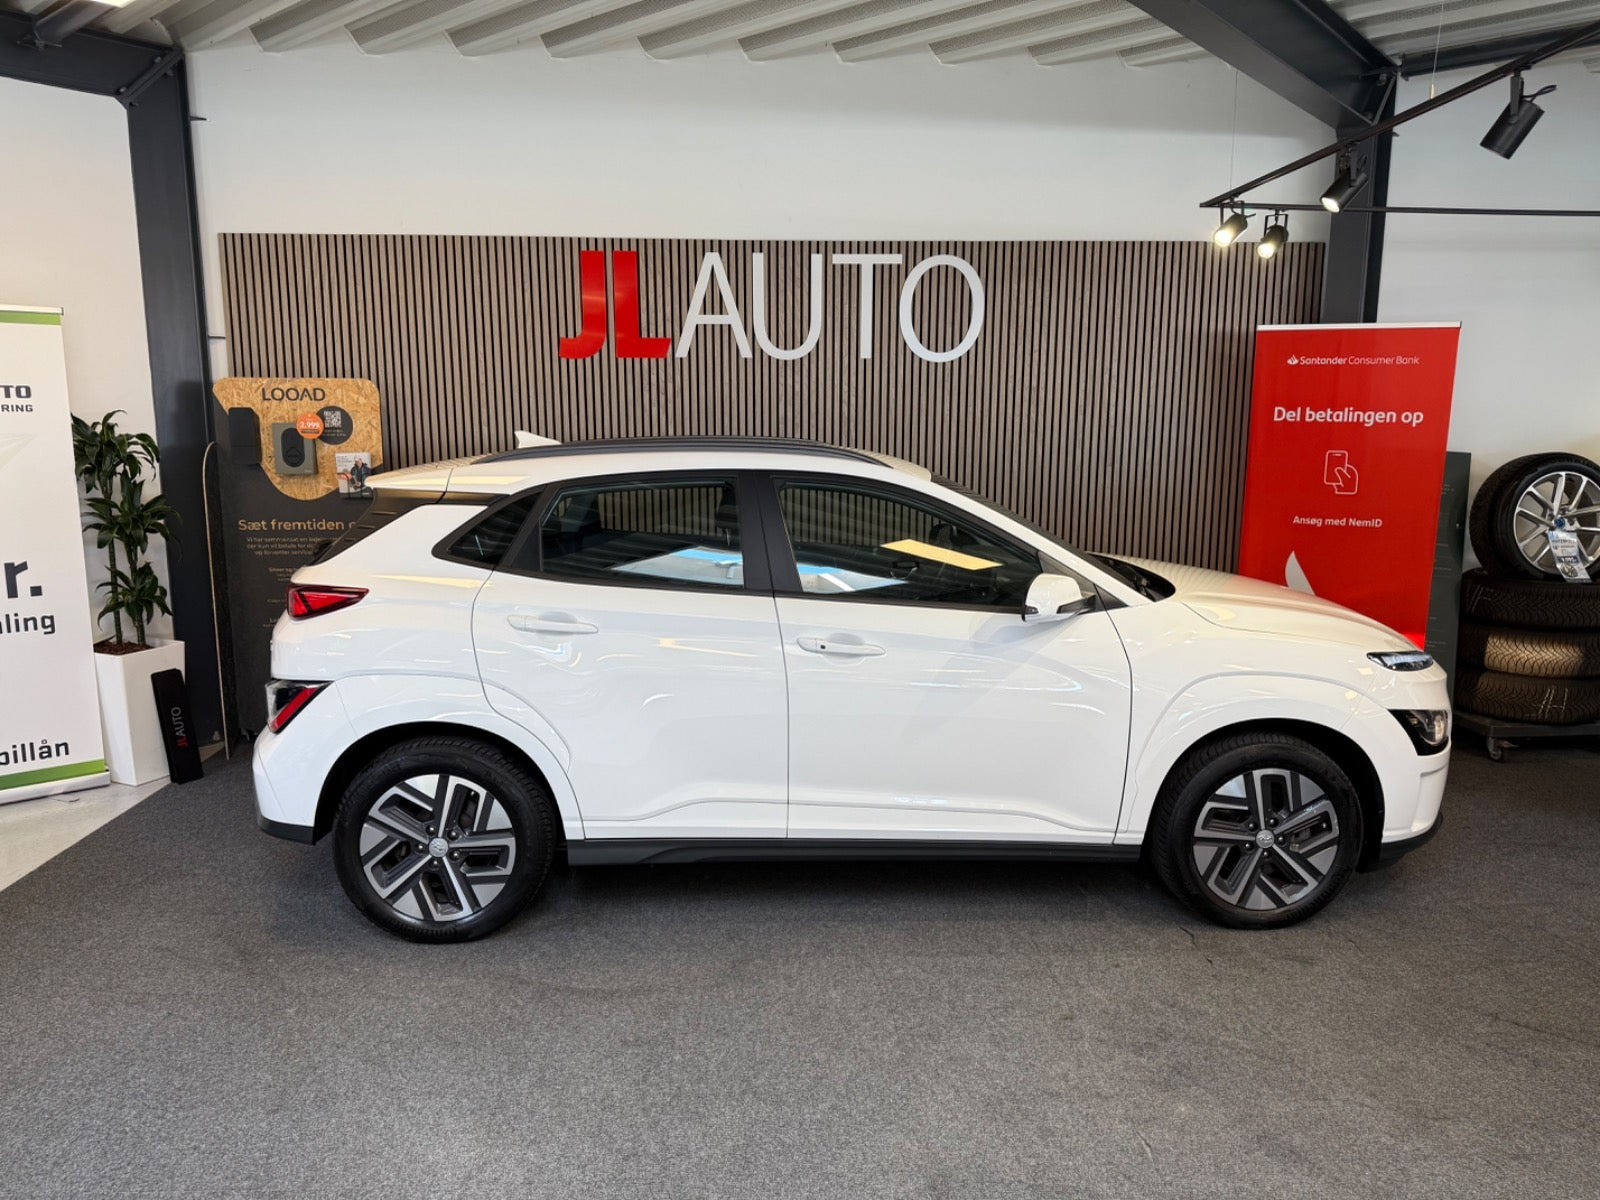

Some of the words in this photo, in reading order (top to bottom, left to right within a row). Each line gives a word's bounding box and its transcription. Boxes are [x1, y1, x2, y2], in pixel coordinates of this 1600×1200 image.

[1300, 355, 1348, 365] Santander
[1348, 355, 1395, 365] Consumer
[1396, 355, 1420, 365] Bank
[0, 385, 32, 399] TO
[261, 387, 326, 401] LOOAD
[1, 404, 33, 412] RING
[1273, 406, 1301, 422] Del
[1305, 406, 1397, 427] betalingen
[1401, 411, 1424, 428] op
[238, 519, 268, 531] Sæt
[270, 518, 345, 531] fremtiden
[1325, 517, 1347, 526] med
[1348, 517, 1383, 528] NemID
[4, 560, 43, 599] r.
[0, 613, 56, 635] ling
